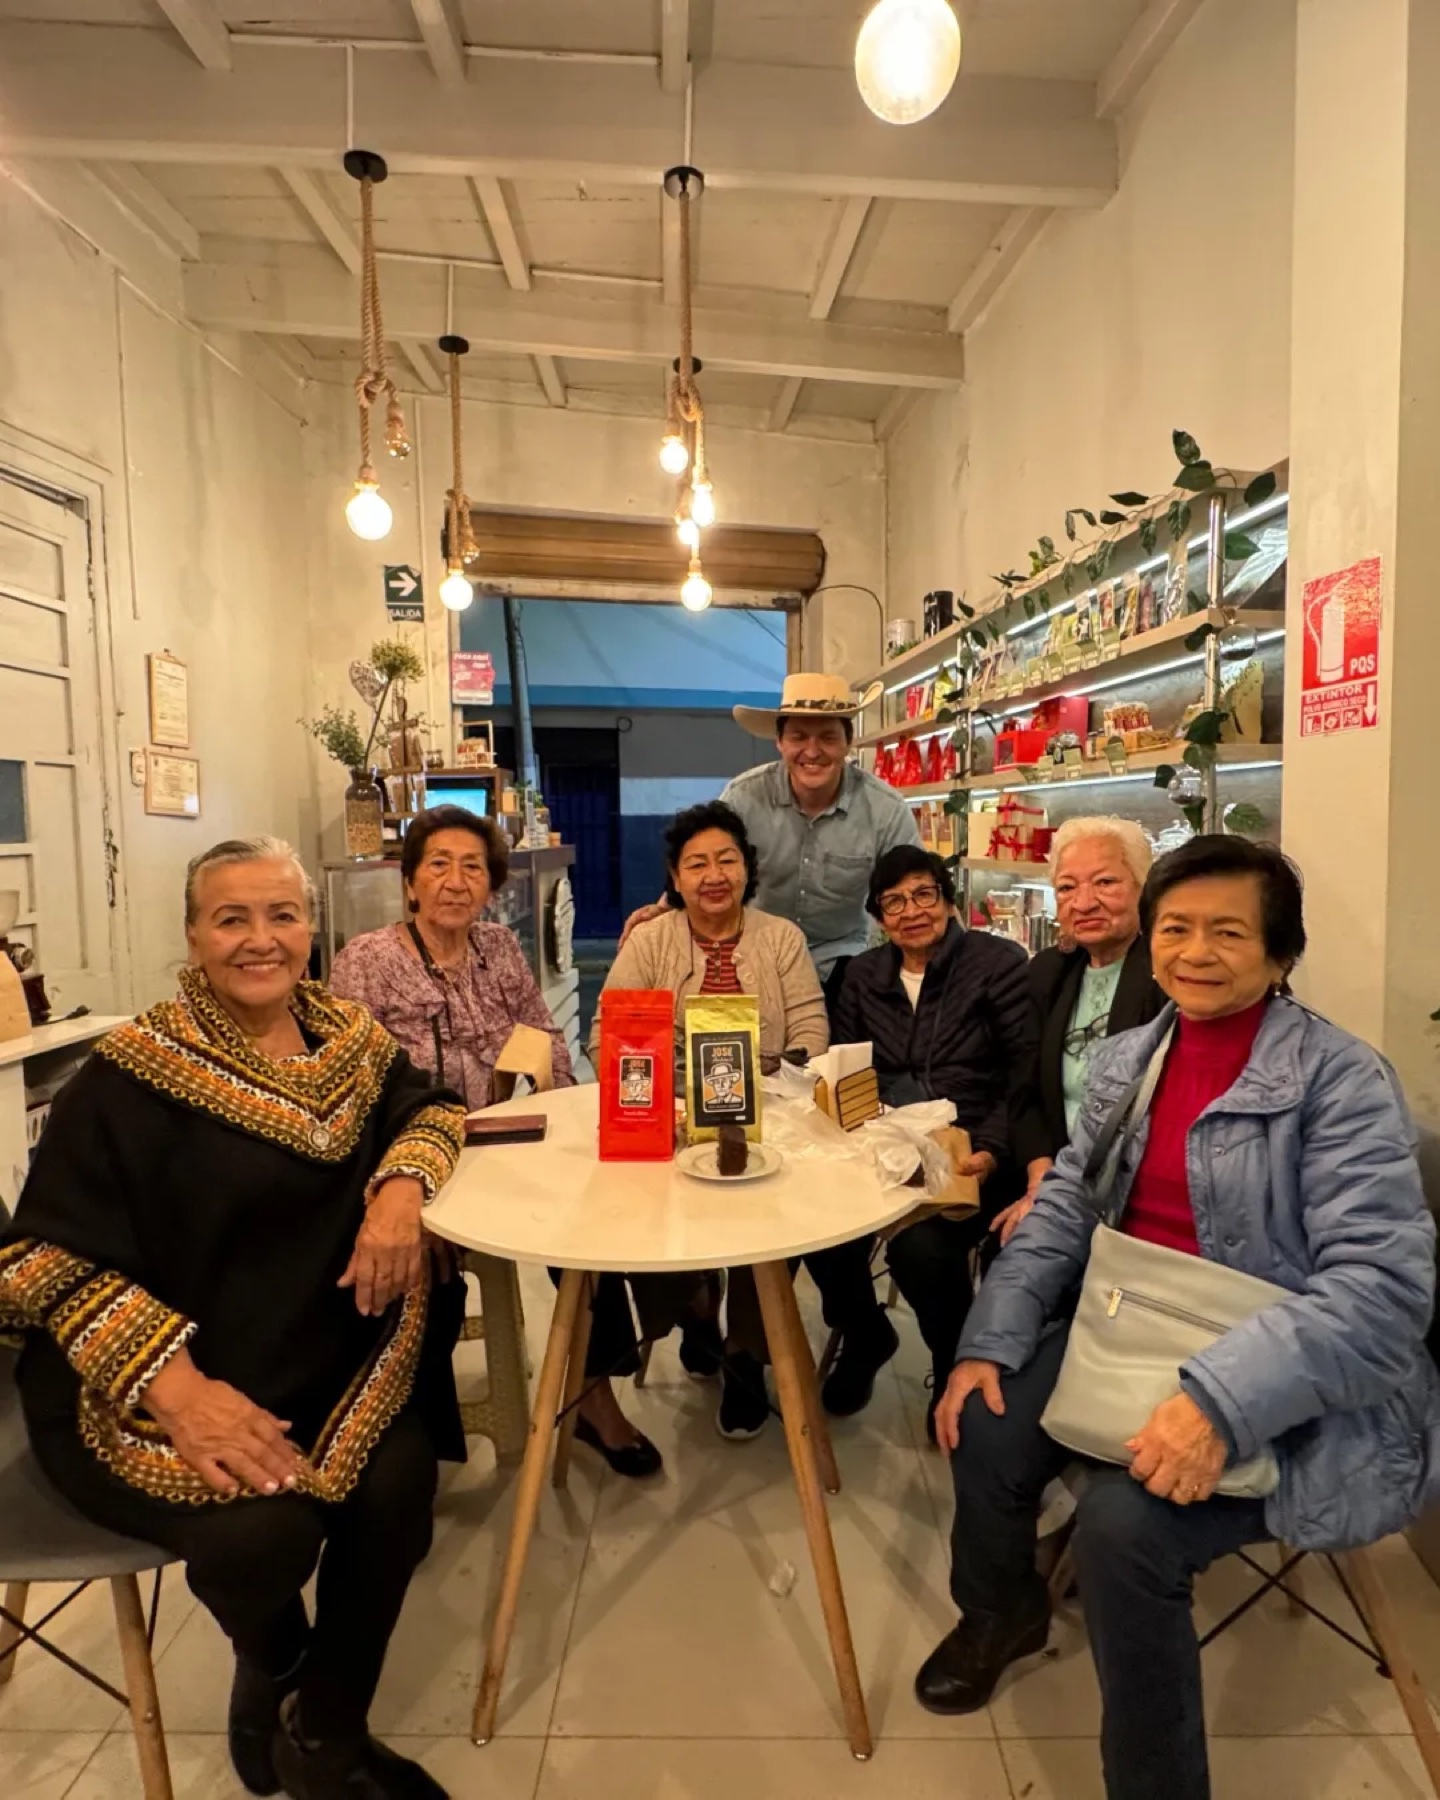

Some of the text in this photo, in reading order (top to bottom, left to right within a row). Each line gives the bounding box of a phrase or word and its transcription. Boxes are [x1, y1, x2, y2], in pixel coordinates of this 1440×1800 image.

[388, 609, 421, 617] SALIDA
[1350, 655, 1375, 675] PQS
[1306, 685, 1362, 703] EXTINTOR
